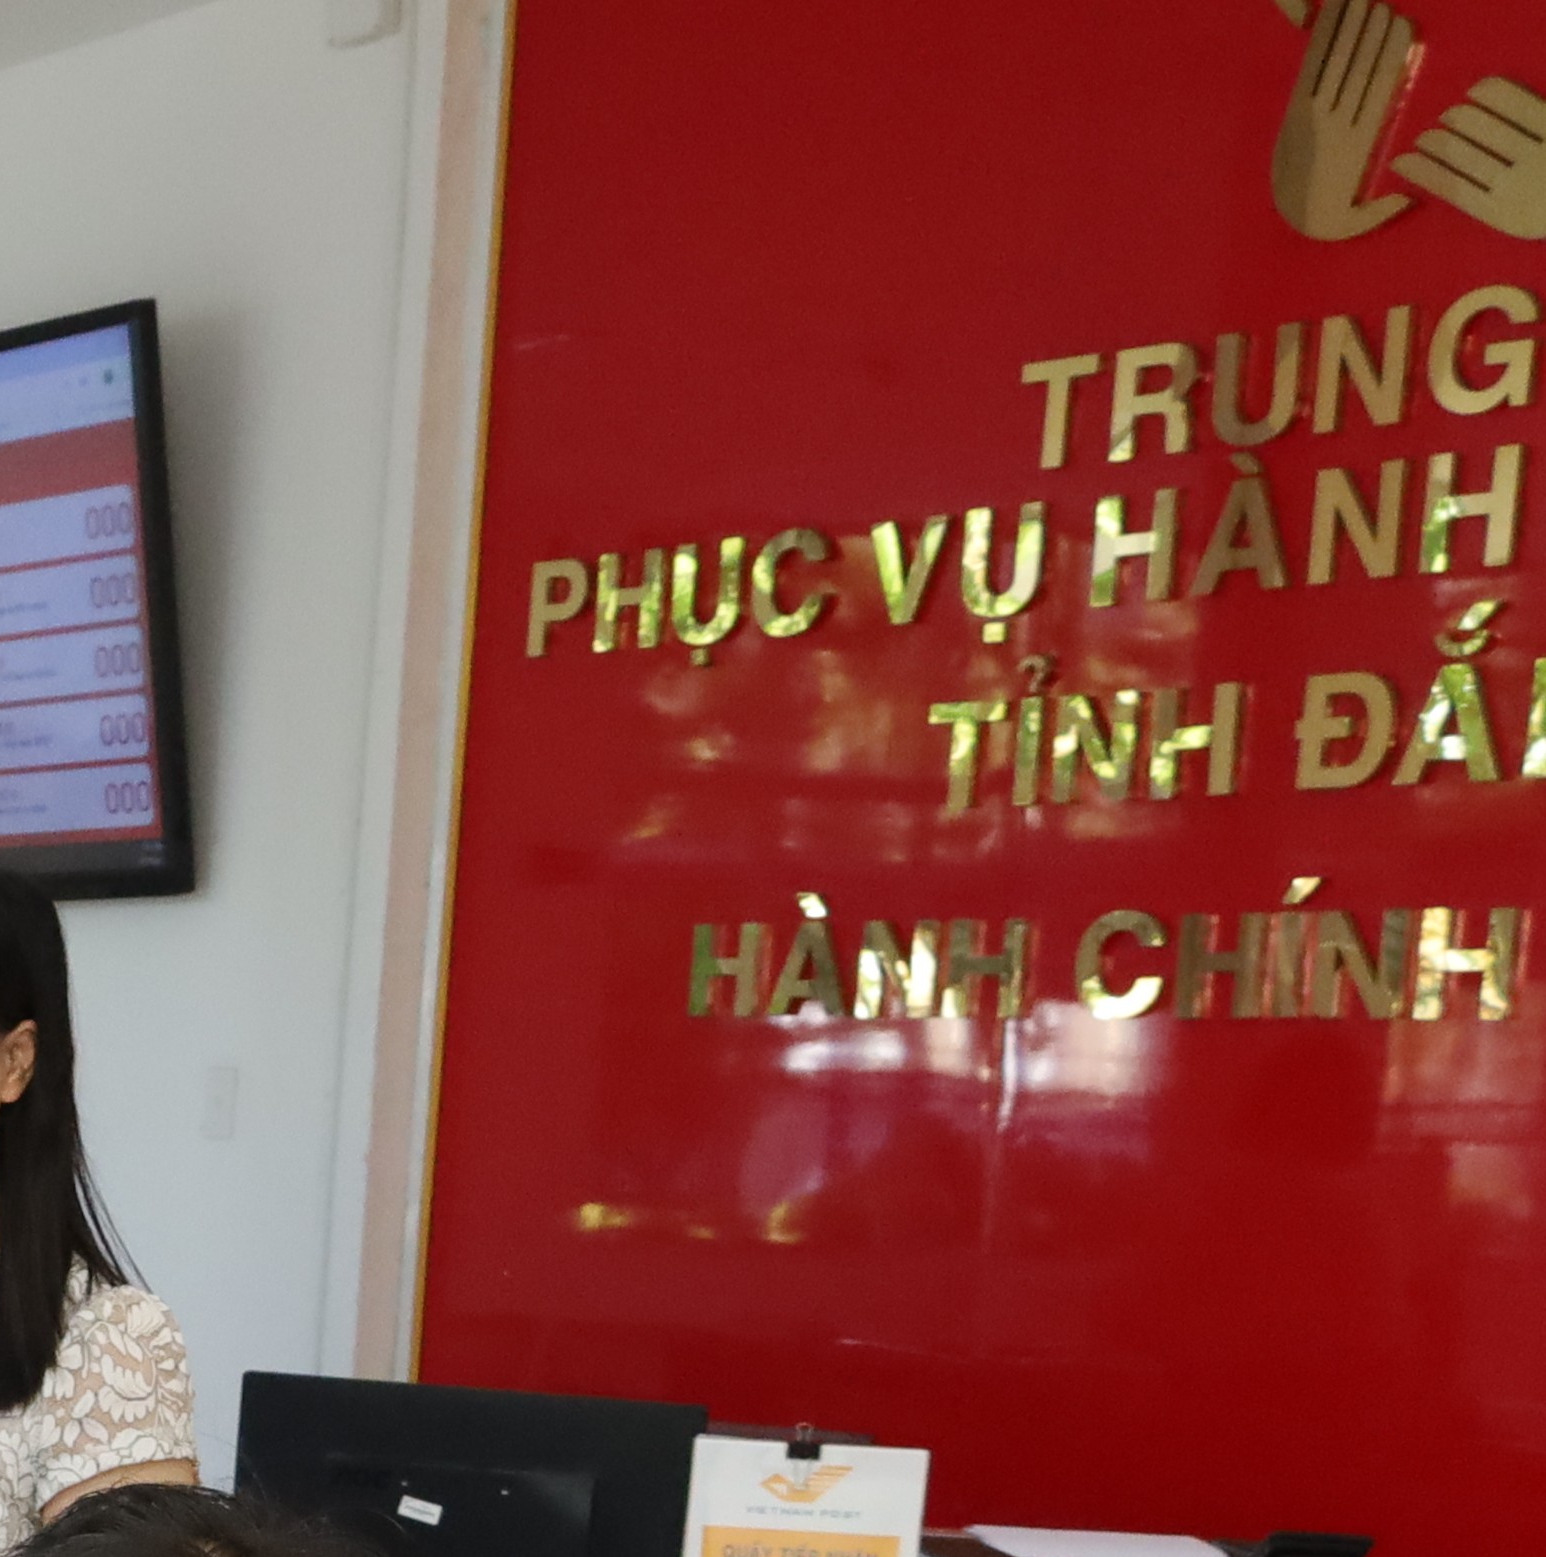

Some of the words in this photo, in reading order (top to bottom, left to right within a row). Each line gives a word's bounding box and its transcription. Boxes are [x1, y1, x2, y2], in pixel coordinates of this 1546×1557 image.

[1020, 284, 1540, 469] TRUNG
[525, 528, 839, 668] PHỤC
[870, 500, 1047, 645] VỤ
[1088, 443, 1522, 608] HÀNH
[928, 655, 1245, 820] TỈNH
[689, 891, 1025, 1019] HÀNH
[1075, 875, 1525, 1021] CHÍNH
